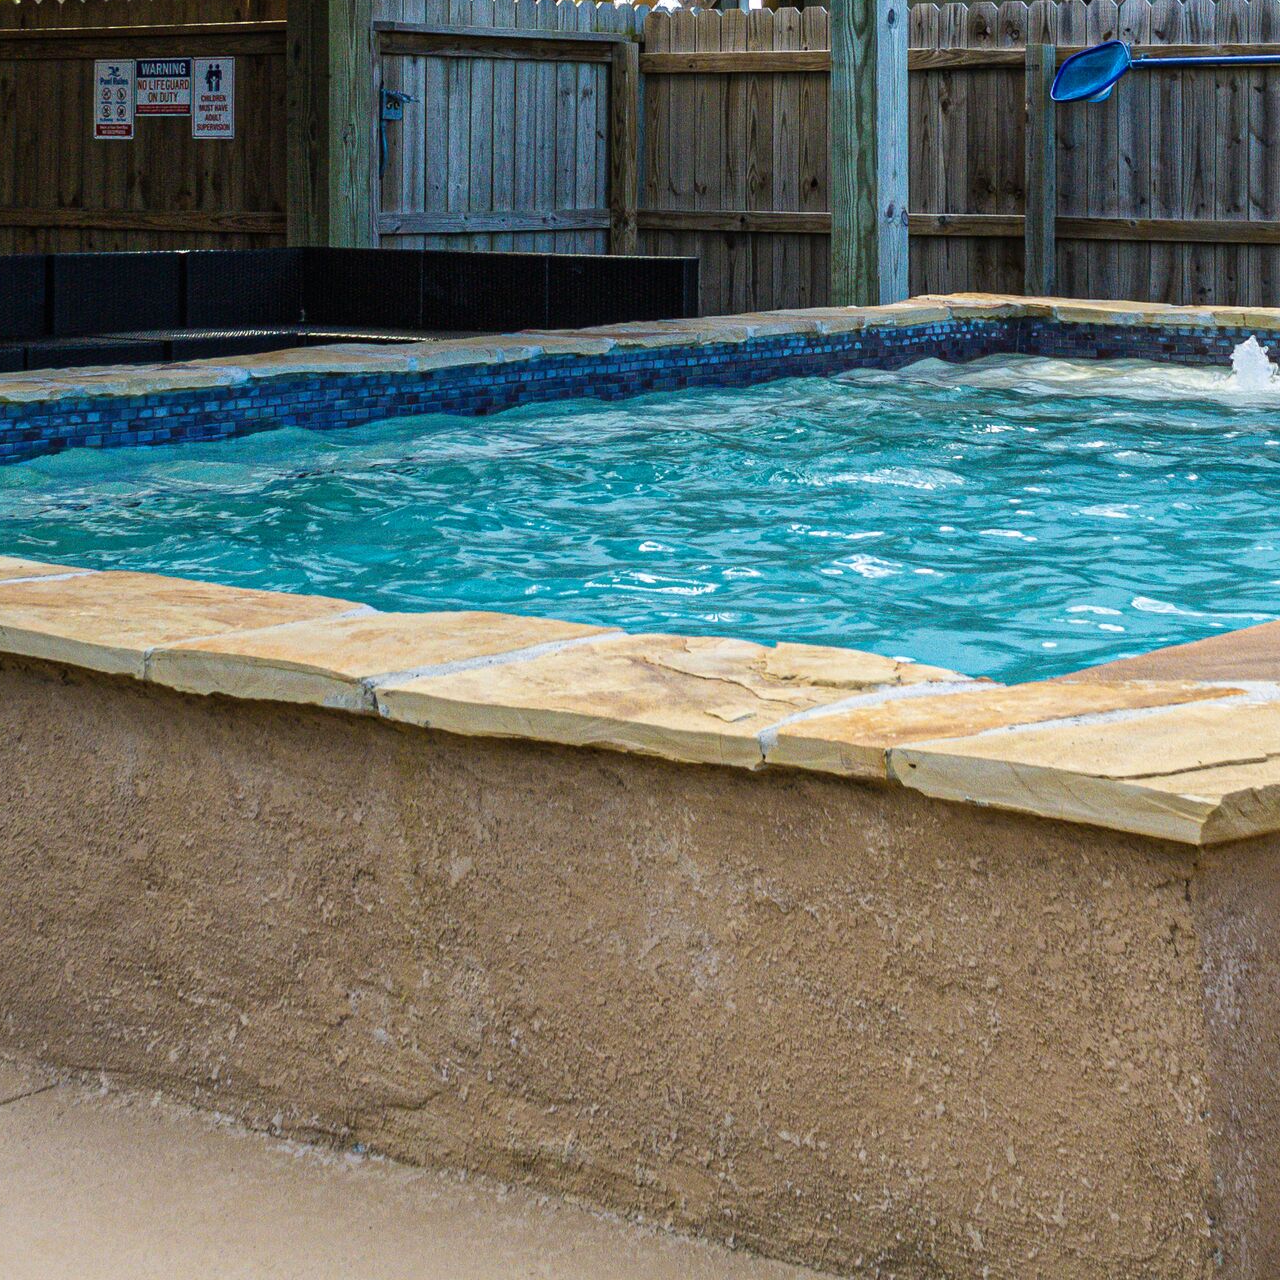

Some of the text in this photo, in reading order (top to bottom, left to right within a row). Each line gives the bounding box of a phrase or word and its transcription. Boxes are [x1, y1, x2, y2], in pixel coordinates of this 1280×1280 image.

[141, 62, 186, 75] WARNING
[137, 79, 189, 90] NO LIFEGUARD
[148, 91, 178, 102] ON DUTY
[201, 94, 226, 102] CHILDREN
[199, 104, 228, 112] MUST HAVE
[205, 113, 222, 121] ADULT
[197, 123, 230, 131] SUPERVISION
